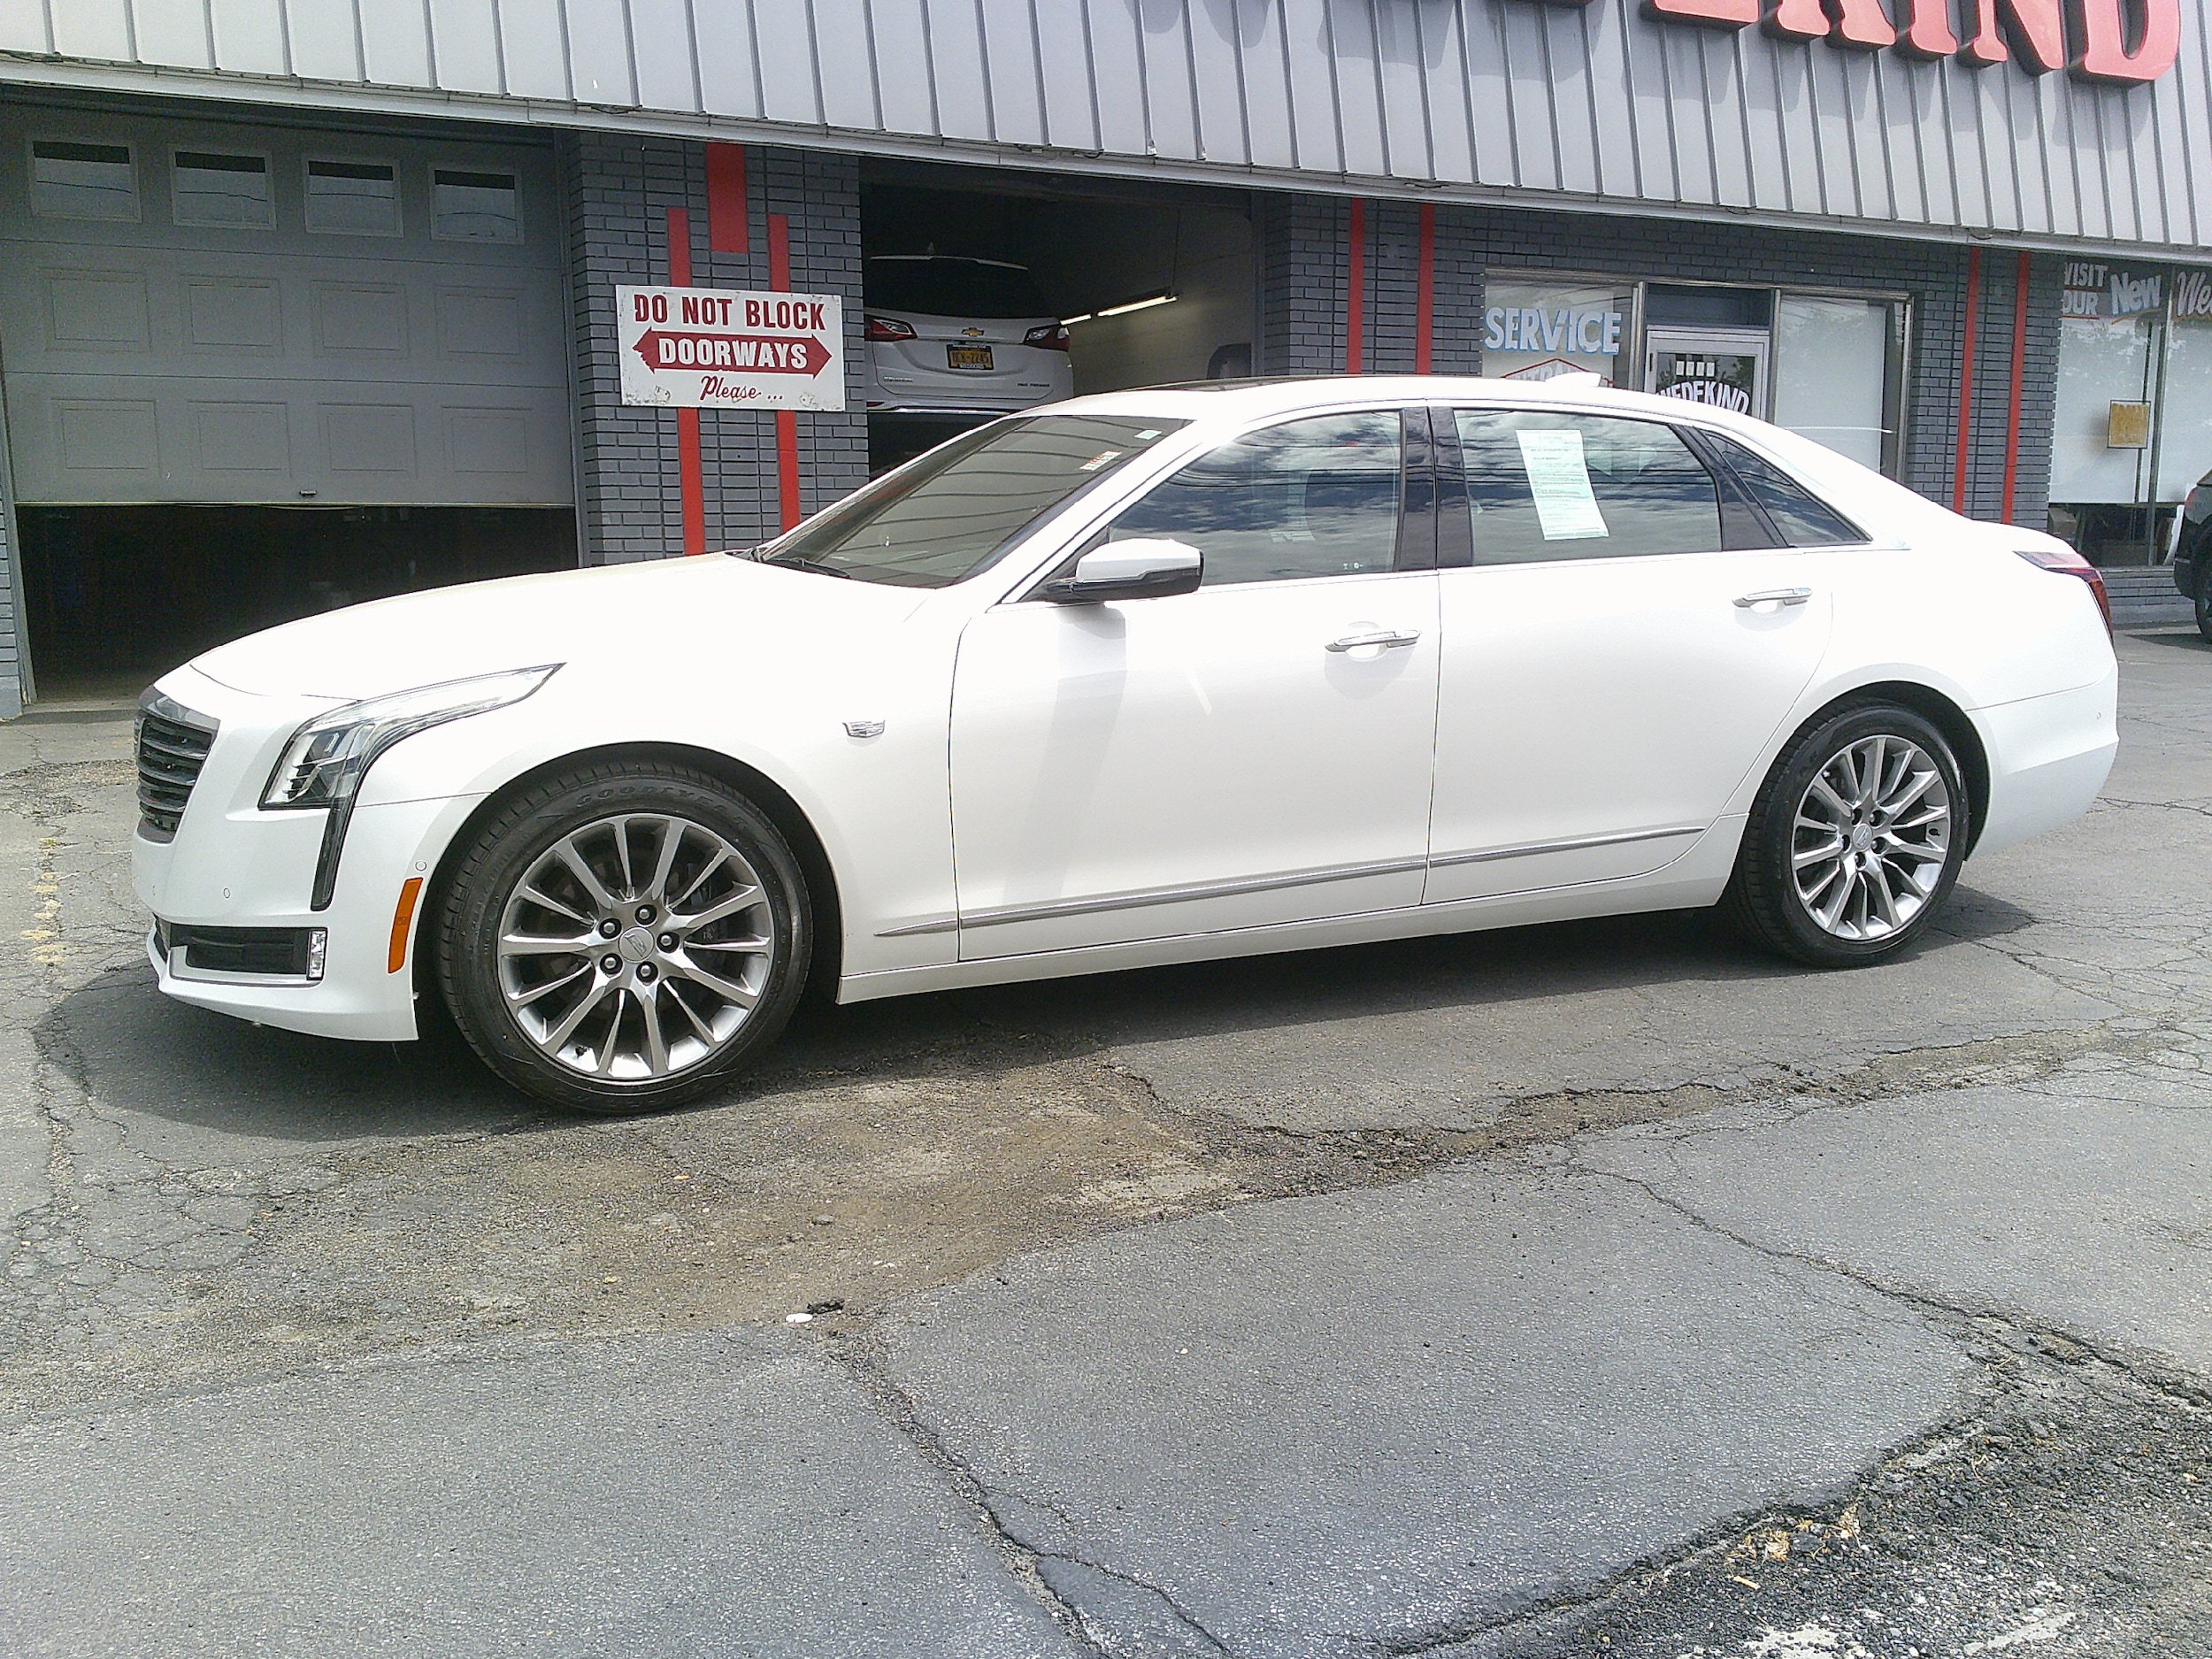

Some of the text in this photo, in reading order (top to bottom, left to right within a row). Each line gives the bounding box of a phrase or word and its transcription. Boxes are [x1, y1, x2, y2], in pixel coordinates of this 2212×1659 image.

[2064, 262, 2108, 287] VISIT
[2061, 272, 2162, 315] OUR New
[2177, 271, 2212, 316] We
[634, 295, 826, 331] DO NOT BLOCK
[1484, 307, 1623, 355] SERVICE
[658, 338, 808, 369] DOORWAYS
[700, 376, 762, 401] Please
